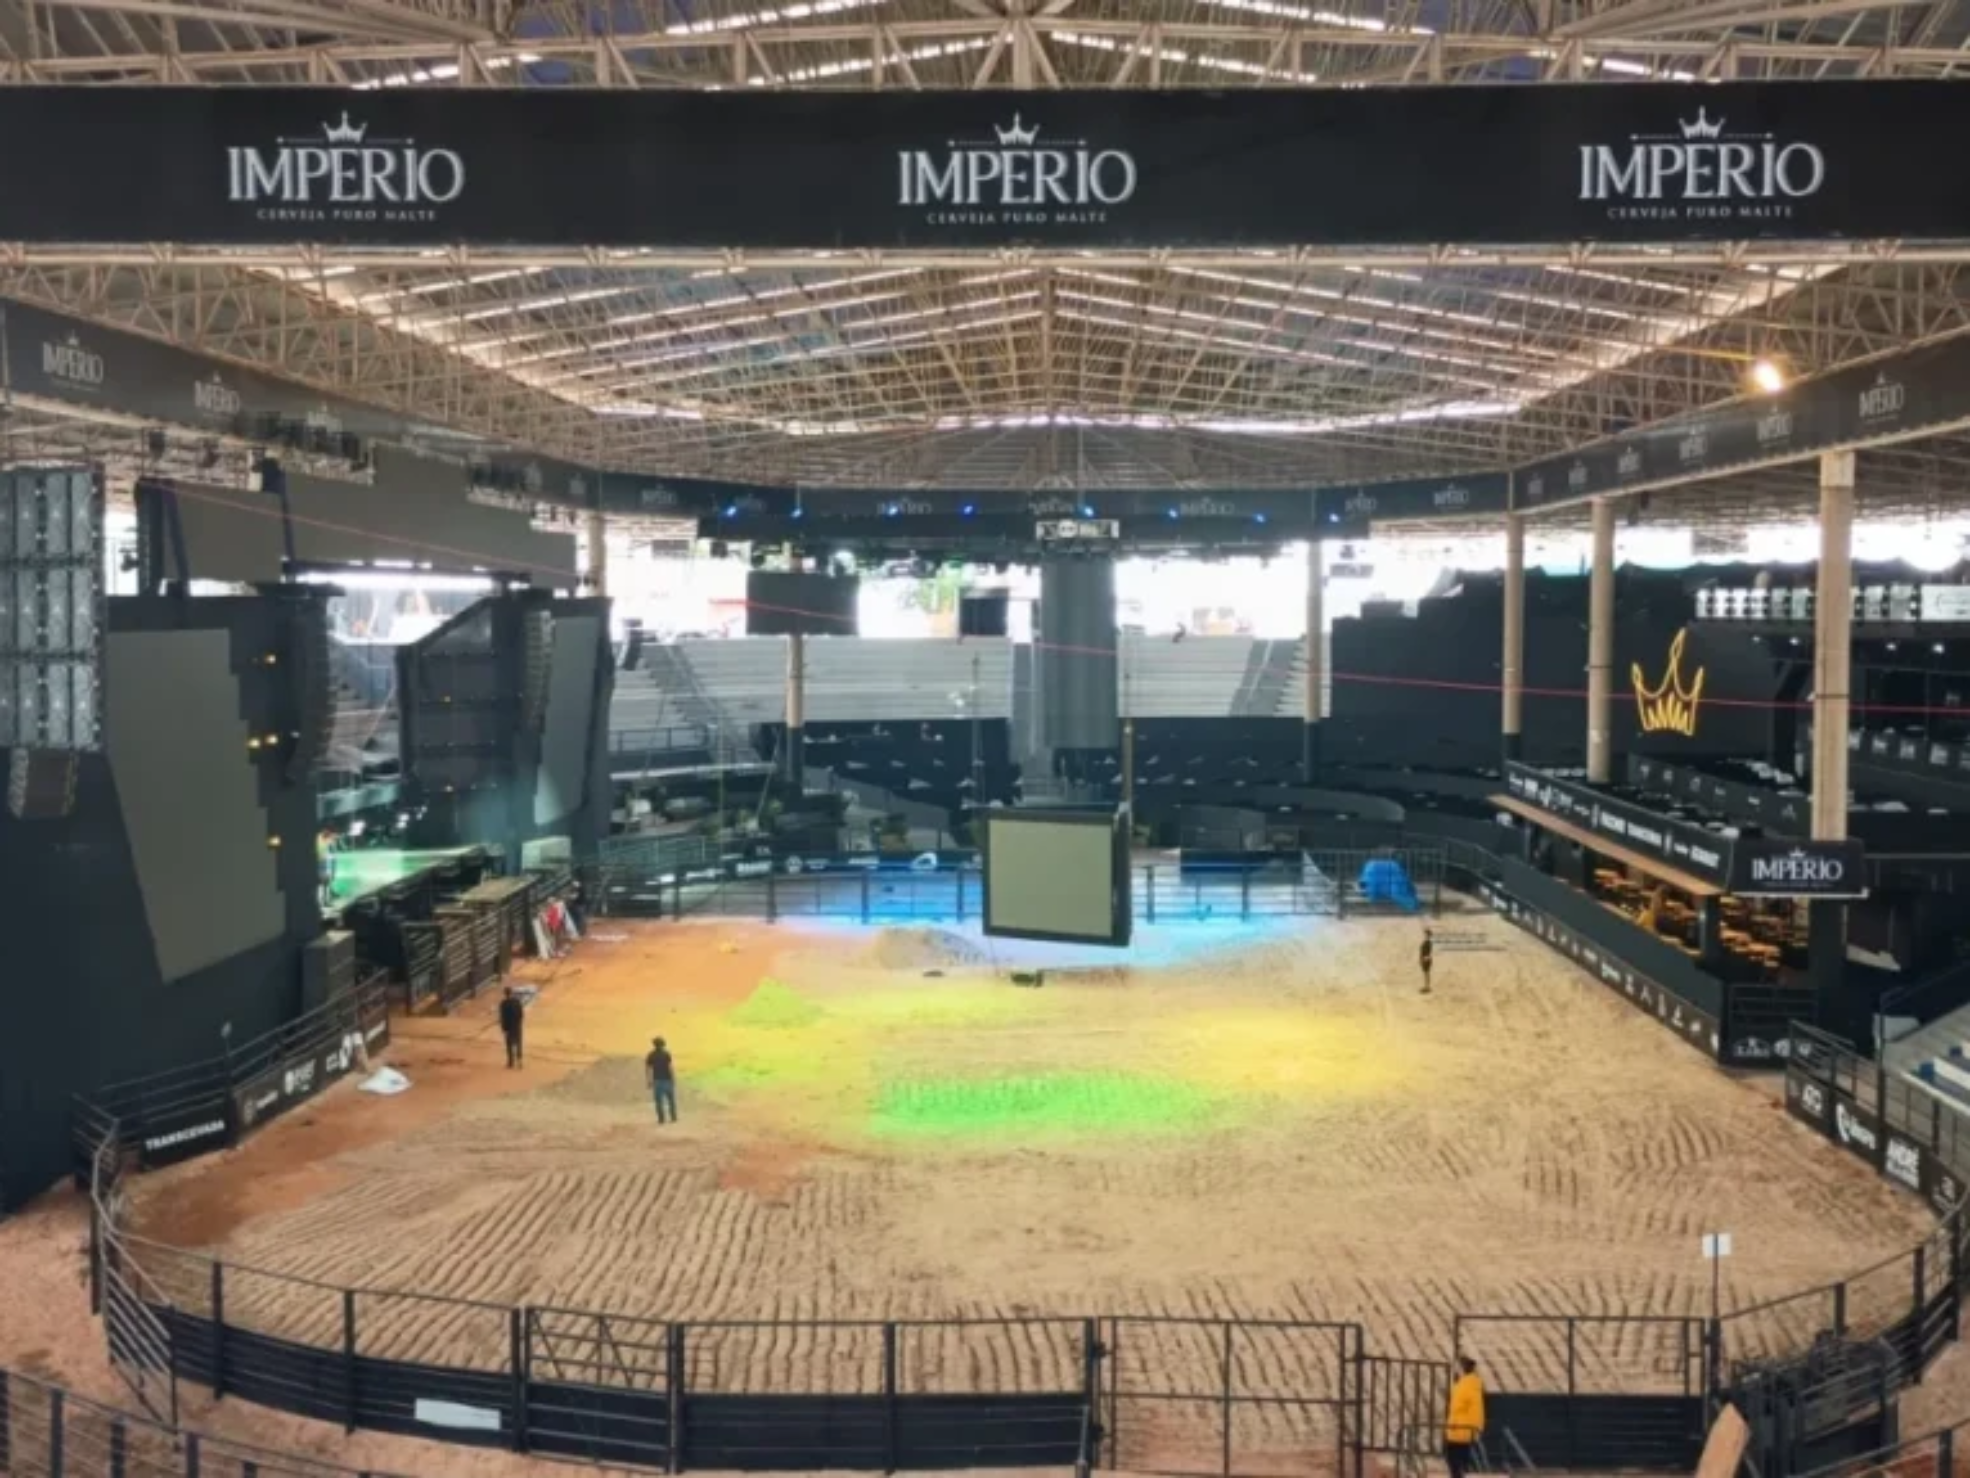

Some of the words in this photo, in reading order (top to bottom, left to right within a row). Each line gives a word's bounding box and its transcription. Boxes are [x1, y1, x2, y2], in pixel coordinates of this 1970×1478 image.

[257, 209, 325, 221] CERVEJA
[333, 210, 377, 220] PURO
[385, 210, 436, 221] MALTE
[926, 212, 996, 224] CERVEJA
[1002, 212, 1047, 223] PURO
[1056, 212, 1107, 223] MALTE
[1607, 207, 1677, 219] CERVEJA
[1687, 206, 1731, 218] PURO
[1739, 206, 1792, 218] MALTE
